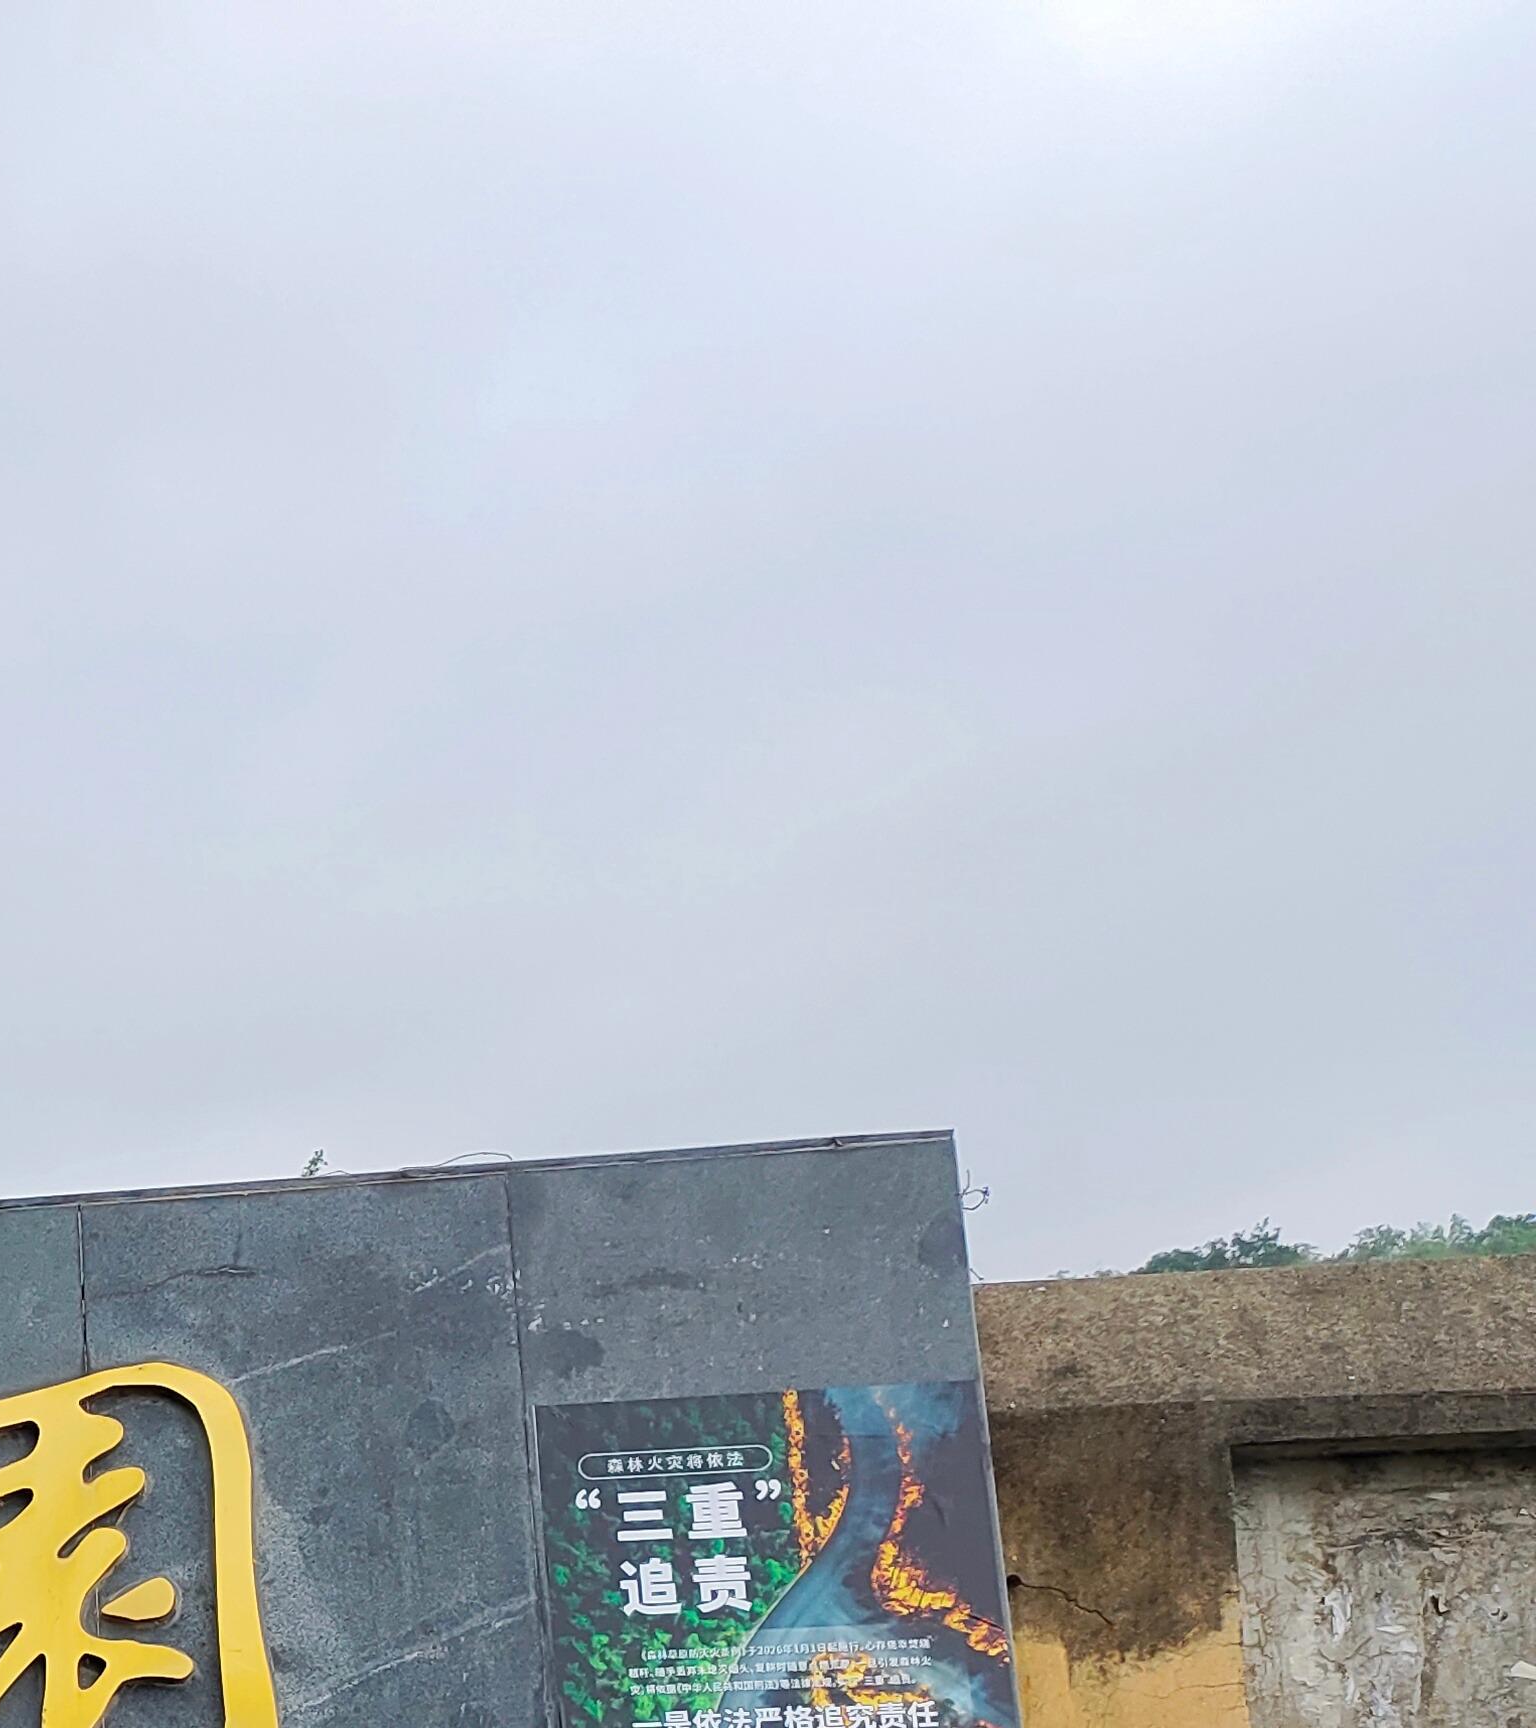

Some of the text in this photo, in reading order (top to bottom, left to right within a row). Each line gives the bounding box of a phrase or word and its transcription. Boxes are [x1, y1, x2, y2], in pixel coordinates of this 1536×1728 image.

[606, 1451, 745, 1474] 森林火灾将依法
[620, 1554, 753, 1616] 追责
